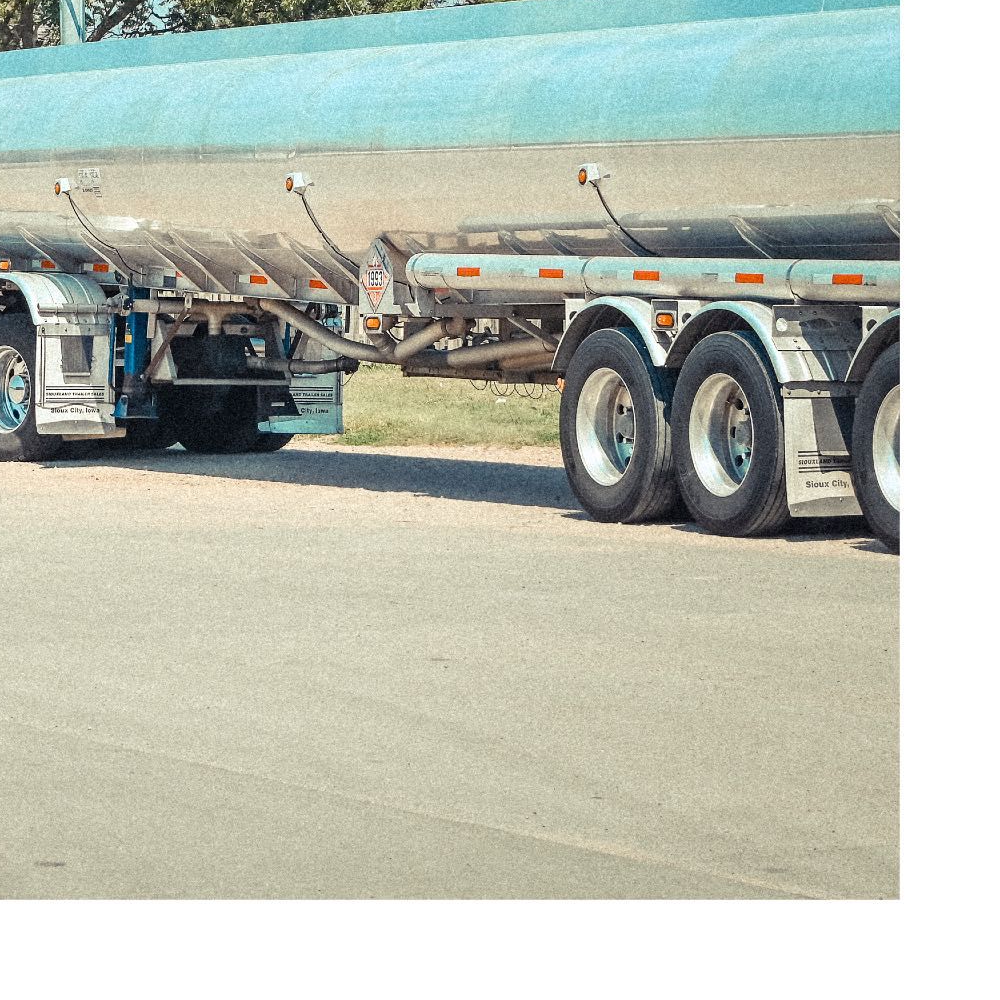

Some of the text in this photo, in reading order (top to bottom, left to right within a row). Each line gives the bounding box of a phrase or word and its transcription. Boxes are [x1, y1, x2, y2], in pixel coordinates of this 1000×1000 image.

[368, 271, 382, 286] 1993
[805, 479, 850, 488] Sioux City,
